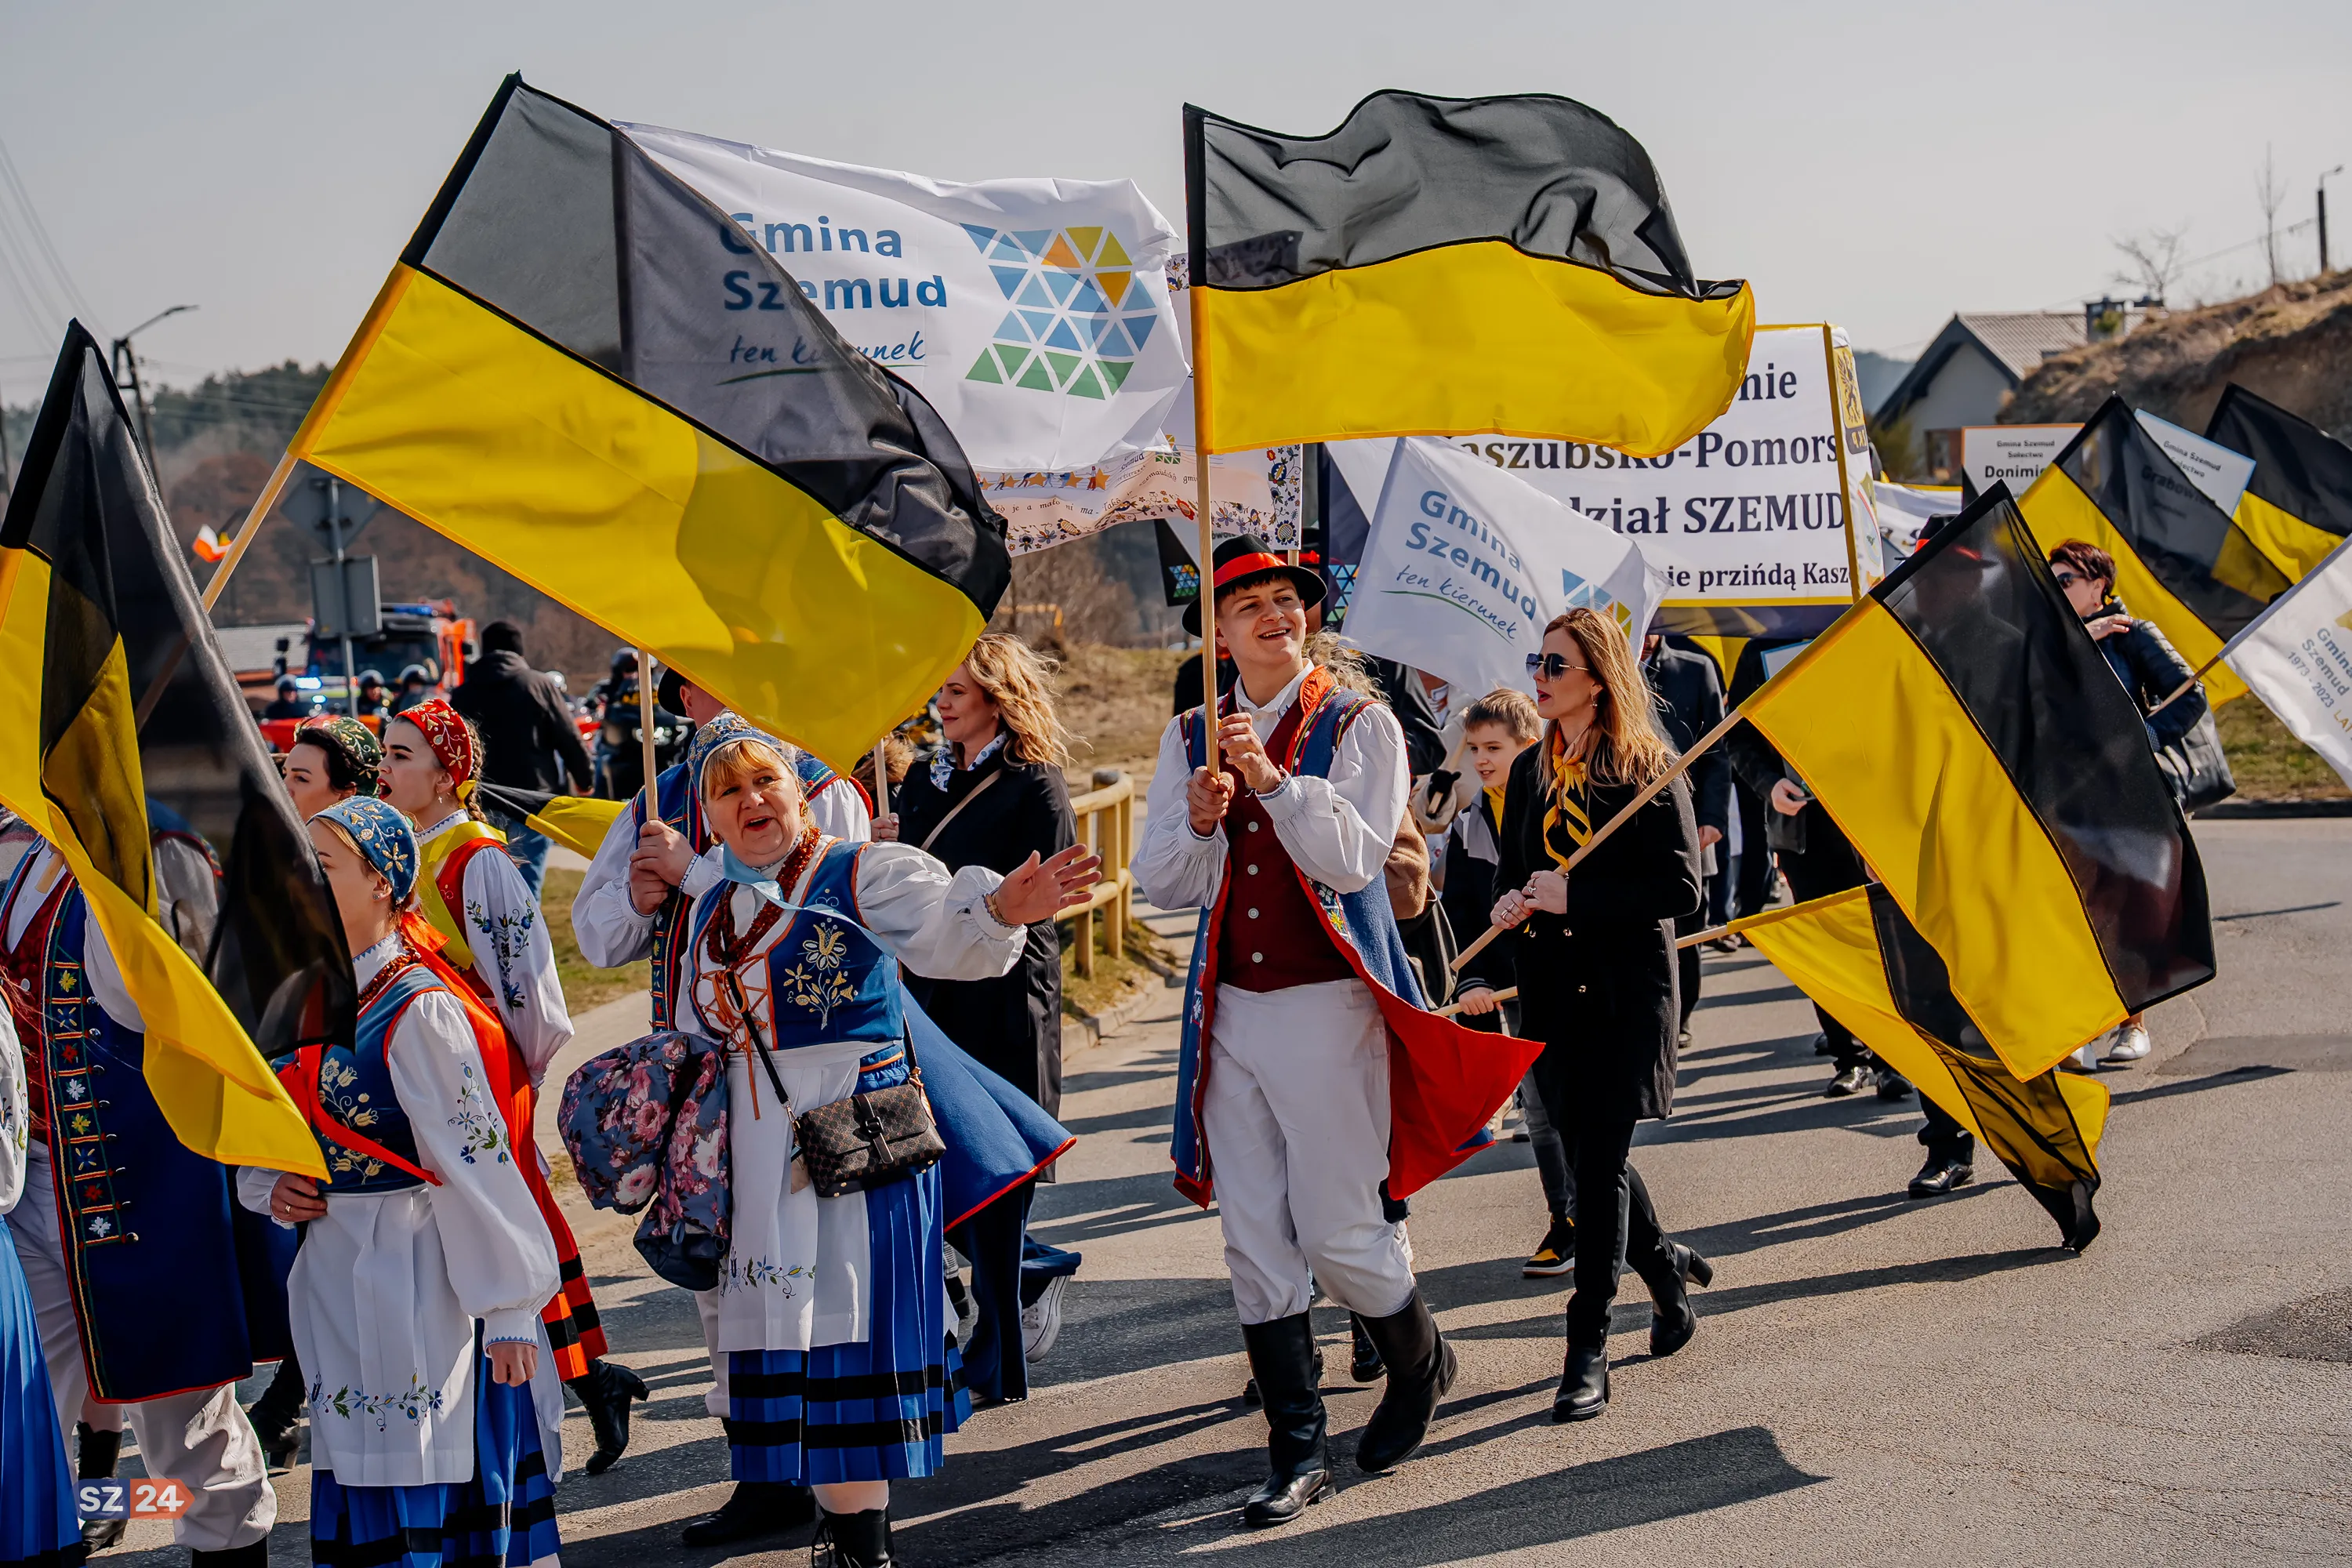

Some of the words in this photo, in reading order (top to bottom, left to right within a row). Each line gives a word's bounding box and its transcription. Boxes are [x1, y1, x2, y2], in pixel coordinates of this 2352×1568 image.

[720, 212, 902, 259] Gmina
[730, 335, 777, 364] ten
[1738, 362, 1797, 401] nie
[1420, 490, 1521, 573] Gmina
[1683, 492, 1845, 534] SZEMUD
[1406, 522, 1537, 621] Szemud
[1698, 562, 1796, 593] przińdą
[1803, 562, 1851, 585] Kasz
[1396, 564, 1429, 588] ten
[1439, 578, 1517, 639] kierunek
[2288, 652, 2310, 677] 1973
[2312, 682, 2335, 708] 2023
[2302, 638, 2350, 696] Szemud
